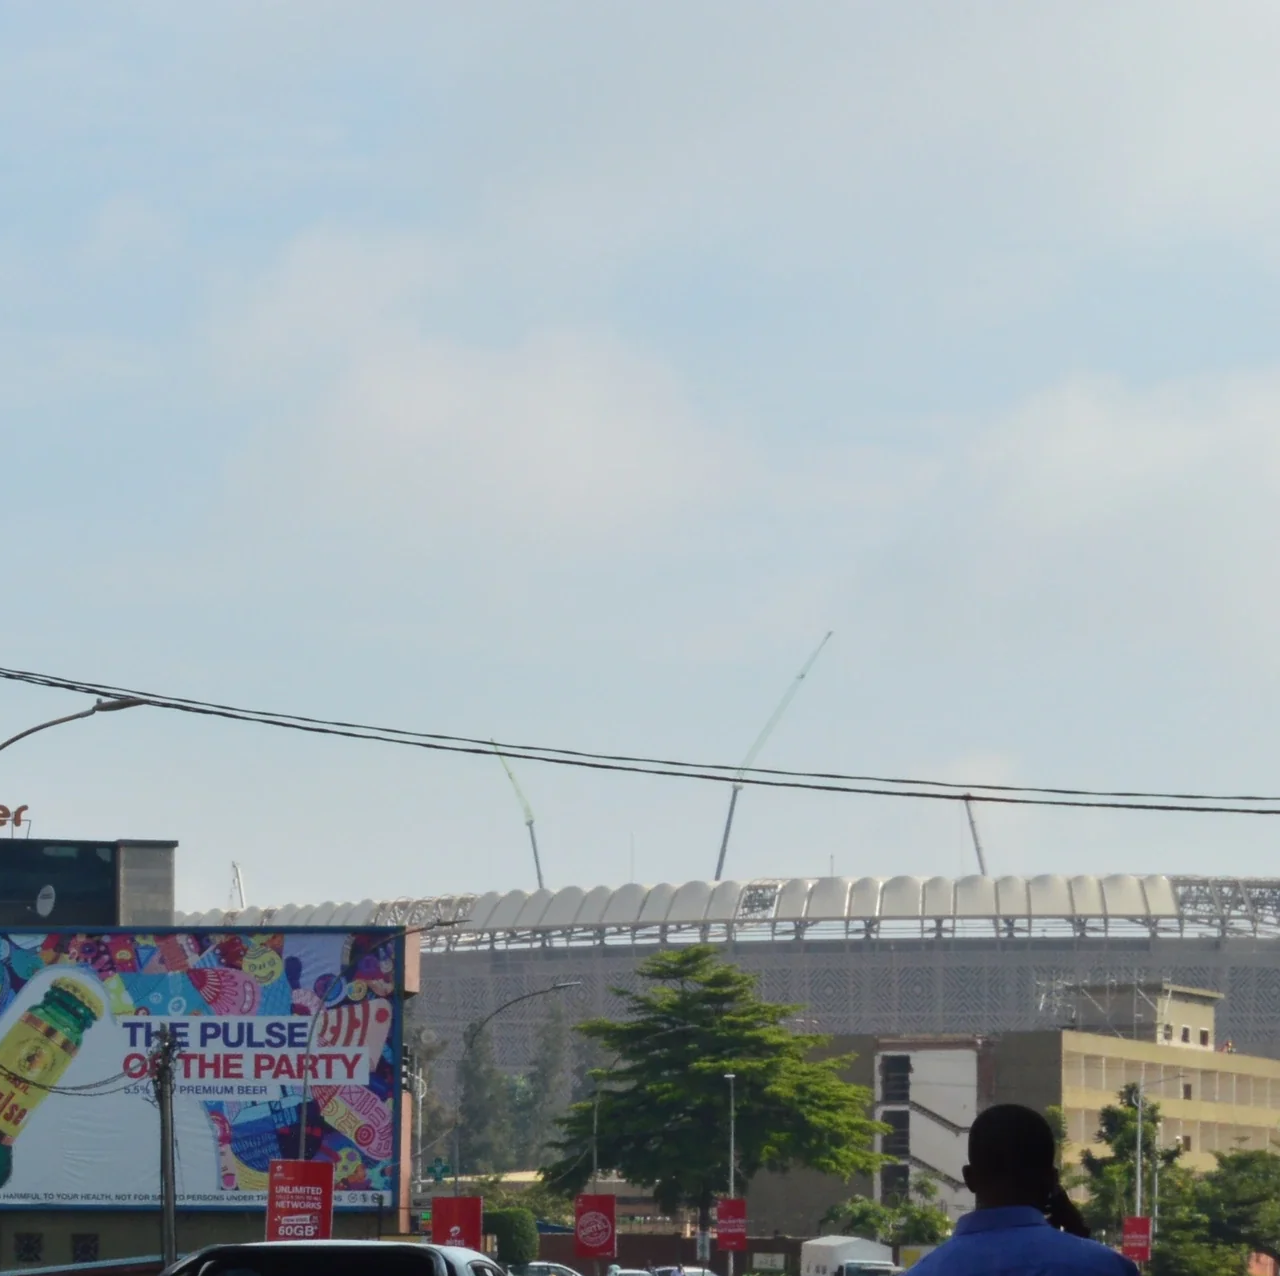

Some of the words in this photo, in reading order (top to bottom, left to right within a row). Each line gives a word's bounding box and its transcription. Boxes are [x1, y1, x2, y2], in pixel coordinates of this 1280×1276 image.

[200, 1021, 308, 1048] PULSE
[176, 1053, 244, 1079] THE
[254, 1053, 363, 1079] PARTY
[179, 1085, 235, 1095] PREMIUM
[238, 1085, 268, 1095] BEER
[275, 1185, 323, 1195] UNLIMITED
[3, 1192, 40, 1200] HARMFUL
[43, 1192, 54, 1200] TO
[56, 1192, 79, 1200] YOUR
[115, 1193, 131, 1201] NOT
[133, 1193, 150, 1201] FOR
[275, 1200, 322, 1210] NETWORKS
